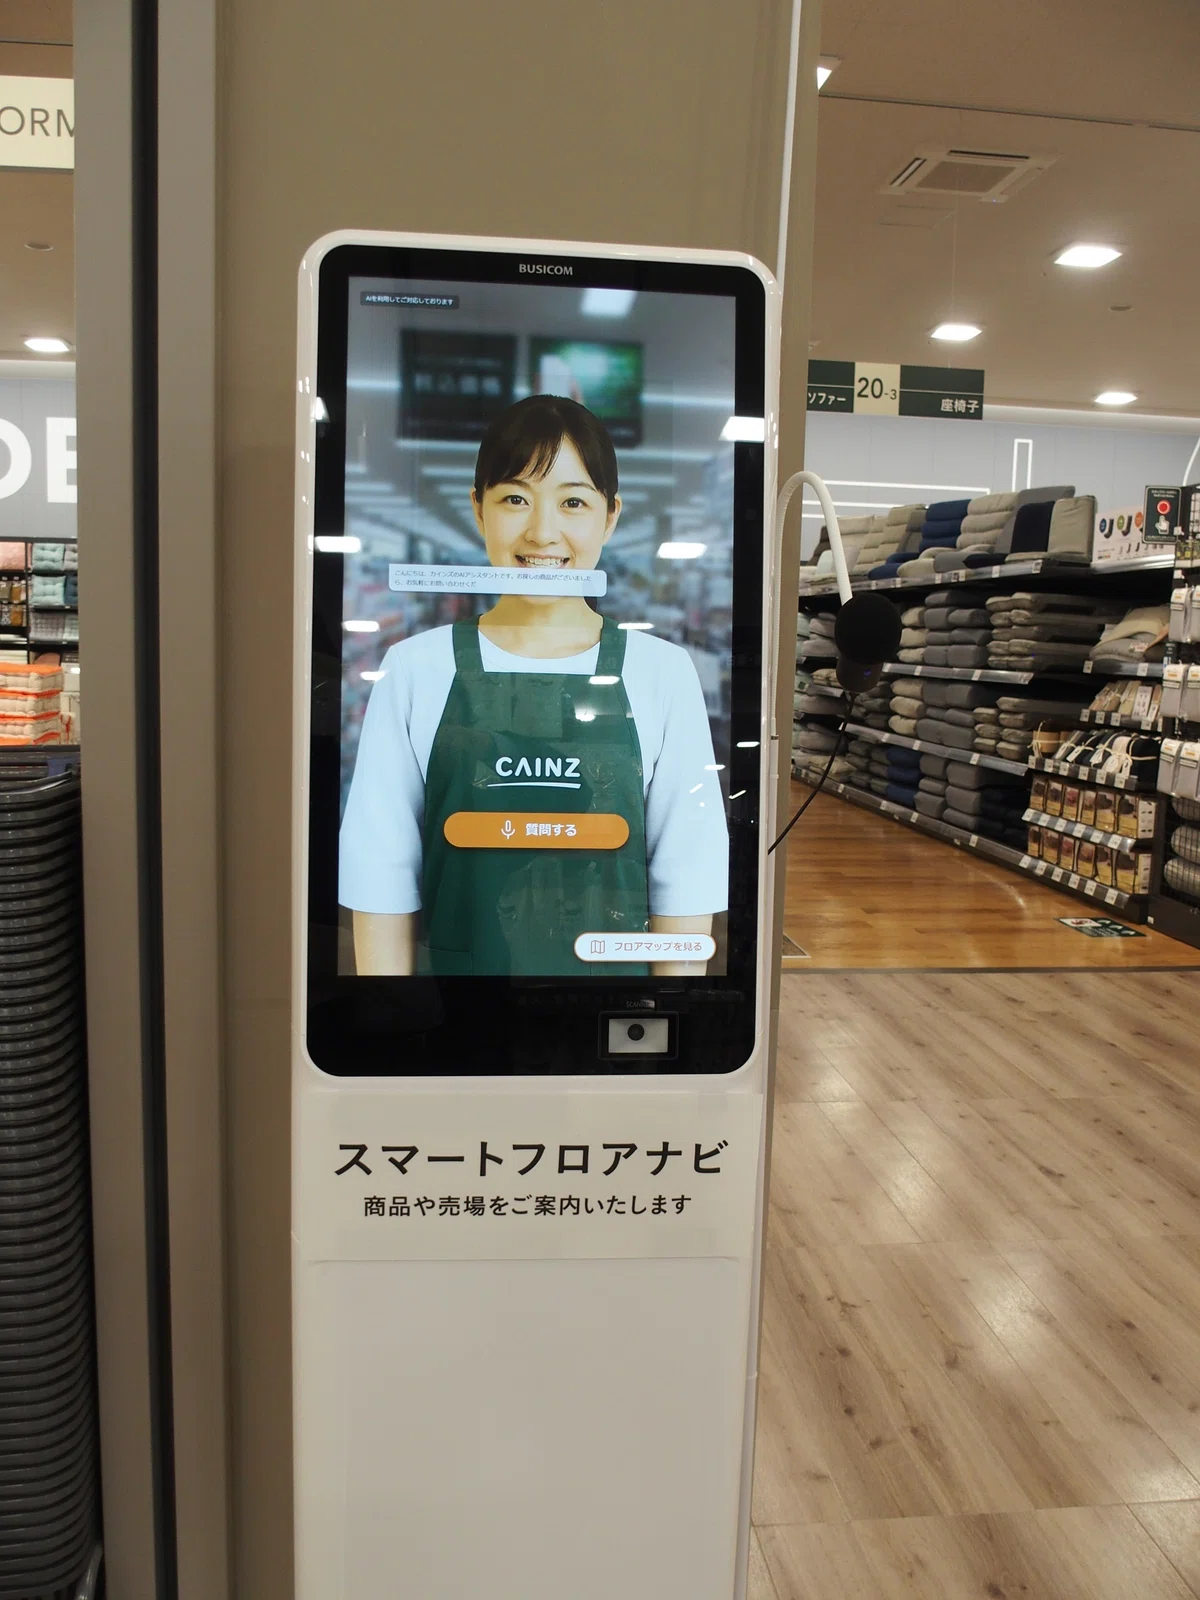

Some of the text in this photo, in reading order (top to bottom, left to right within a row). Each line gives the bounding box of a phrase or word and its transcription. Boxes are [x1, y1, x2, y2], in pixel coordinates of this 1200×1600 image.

[519, 263, 573, 276] BUSICOM
[365, 295, 454, 306] AIを利用してご対応しております
[940, 398, 979, 413] 座椅子
[495, 756, 581, 778] CAINZ
[525, 823, 577, 837] 質問する
[614, 941, 703, 952] フロアマップを見る
[334, 1139, 730, 1177] スマートフロアナビ
[364, 1194, 692, 1217] 商品や売場をご案内いたします
